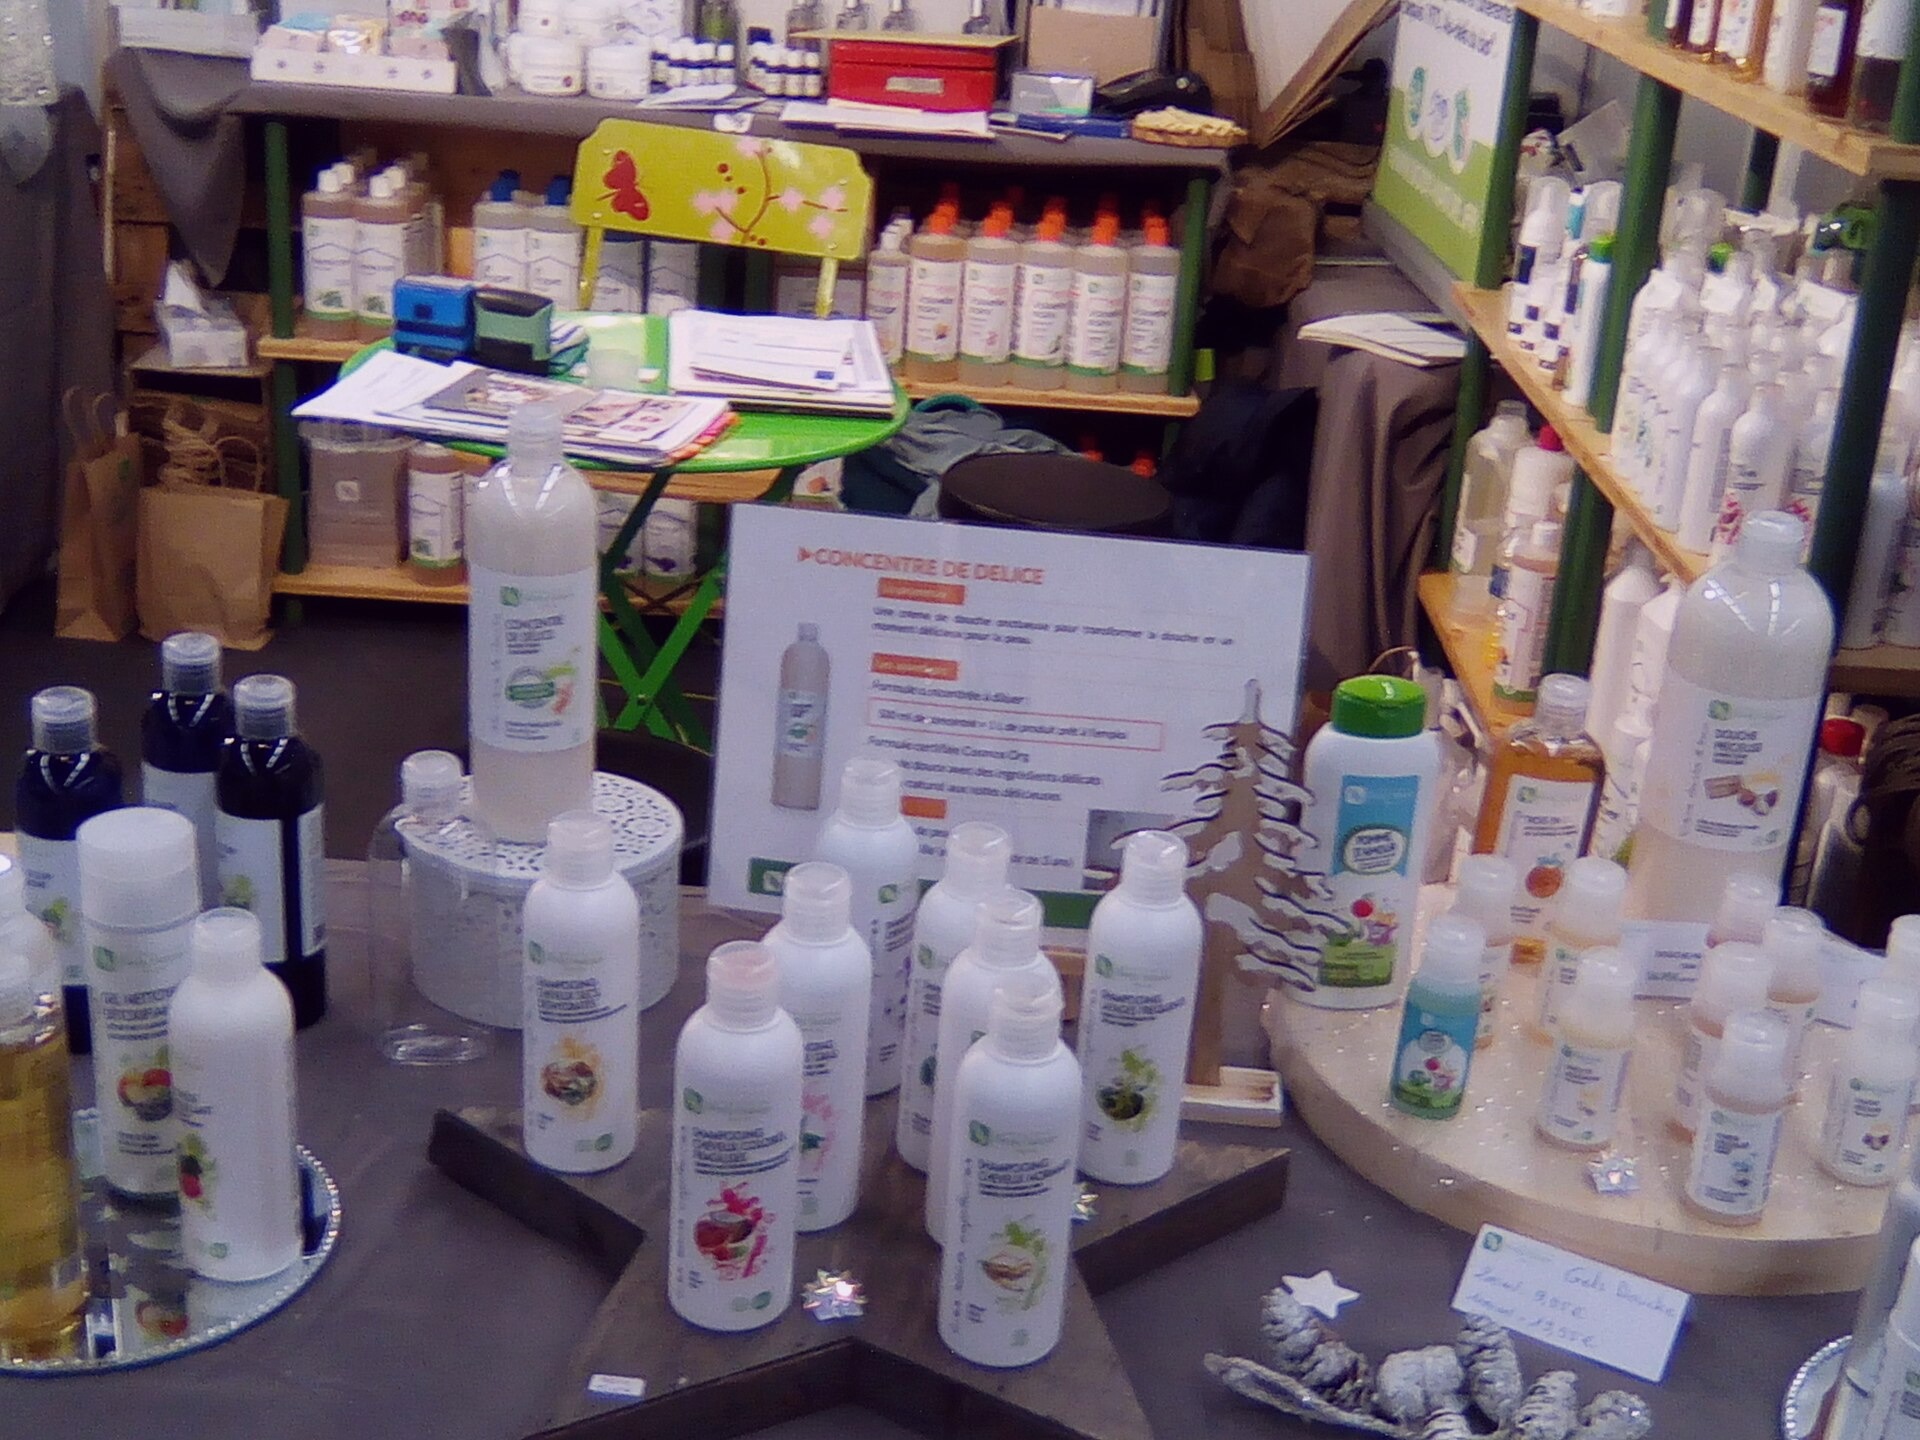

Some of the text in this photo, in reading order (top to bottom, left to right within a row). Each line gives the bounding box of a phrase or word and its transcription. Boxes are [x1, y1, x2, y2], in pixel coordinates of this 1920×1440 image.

[815, 548, 1045, 585] CONCENTRE DE DELICE
